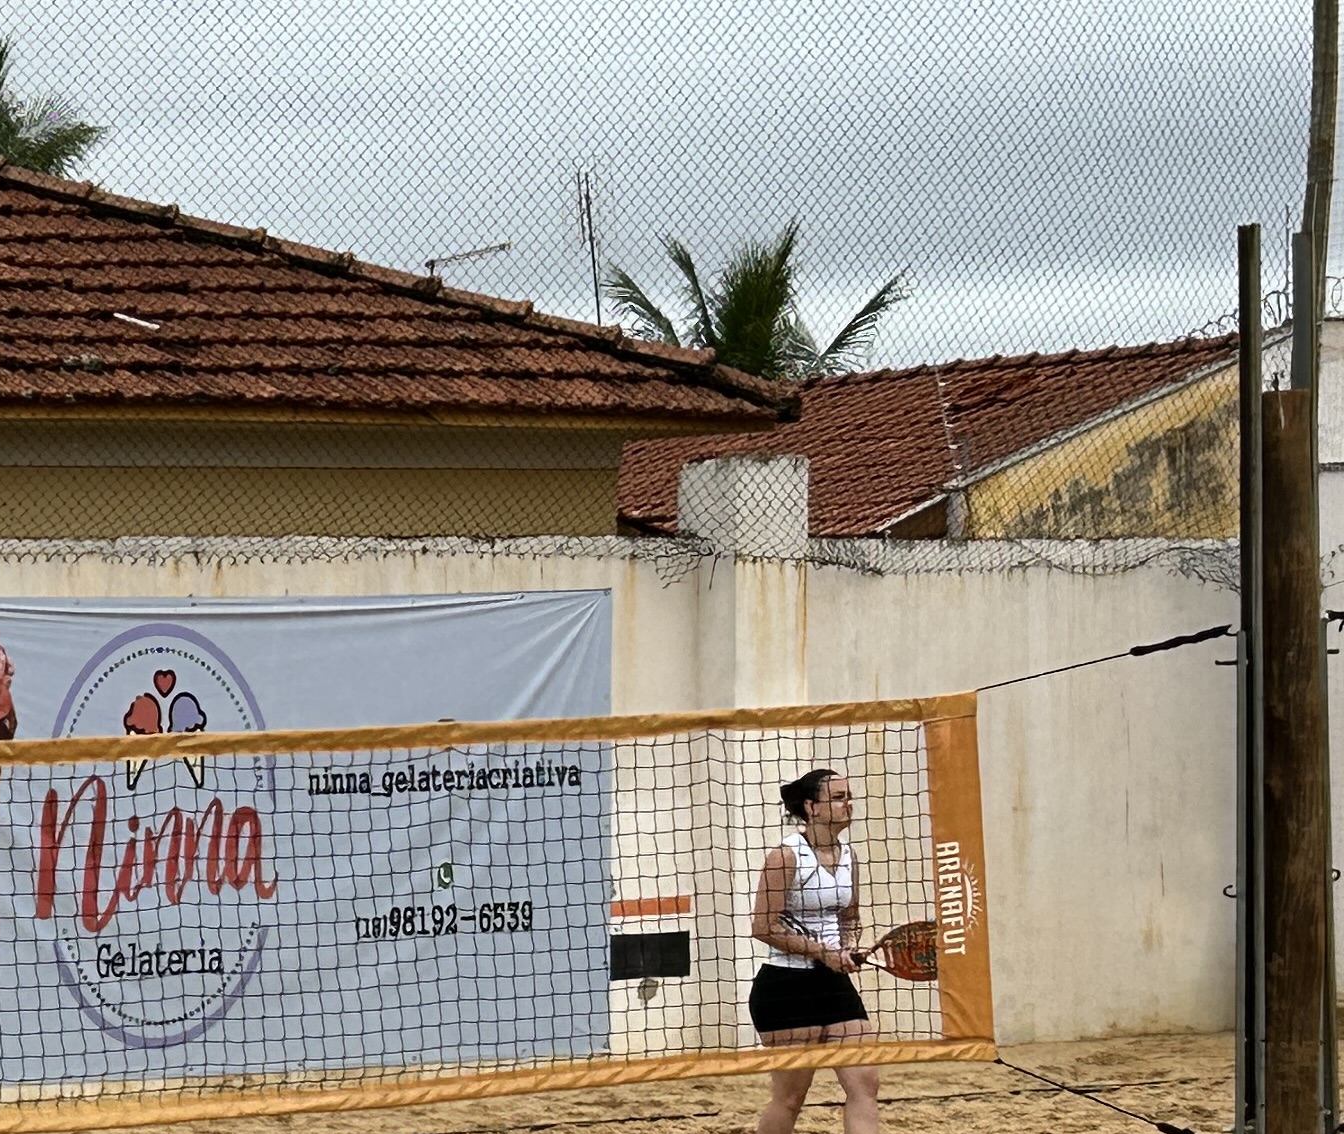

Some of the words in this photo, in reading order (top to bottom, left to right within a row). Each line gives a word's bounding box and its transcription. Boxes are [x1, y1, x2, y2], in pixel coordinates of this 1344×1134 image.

[308, 760, 582, 797] ninna_gelateriacriativa
[34, 774, 279, 933] Ninna
[936, 841, 965, 955] ARENAFUT
[96, 941, 224, 979] Gelateria
